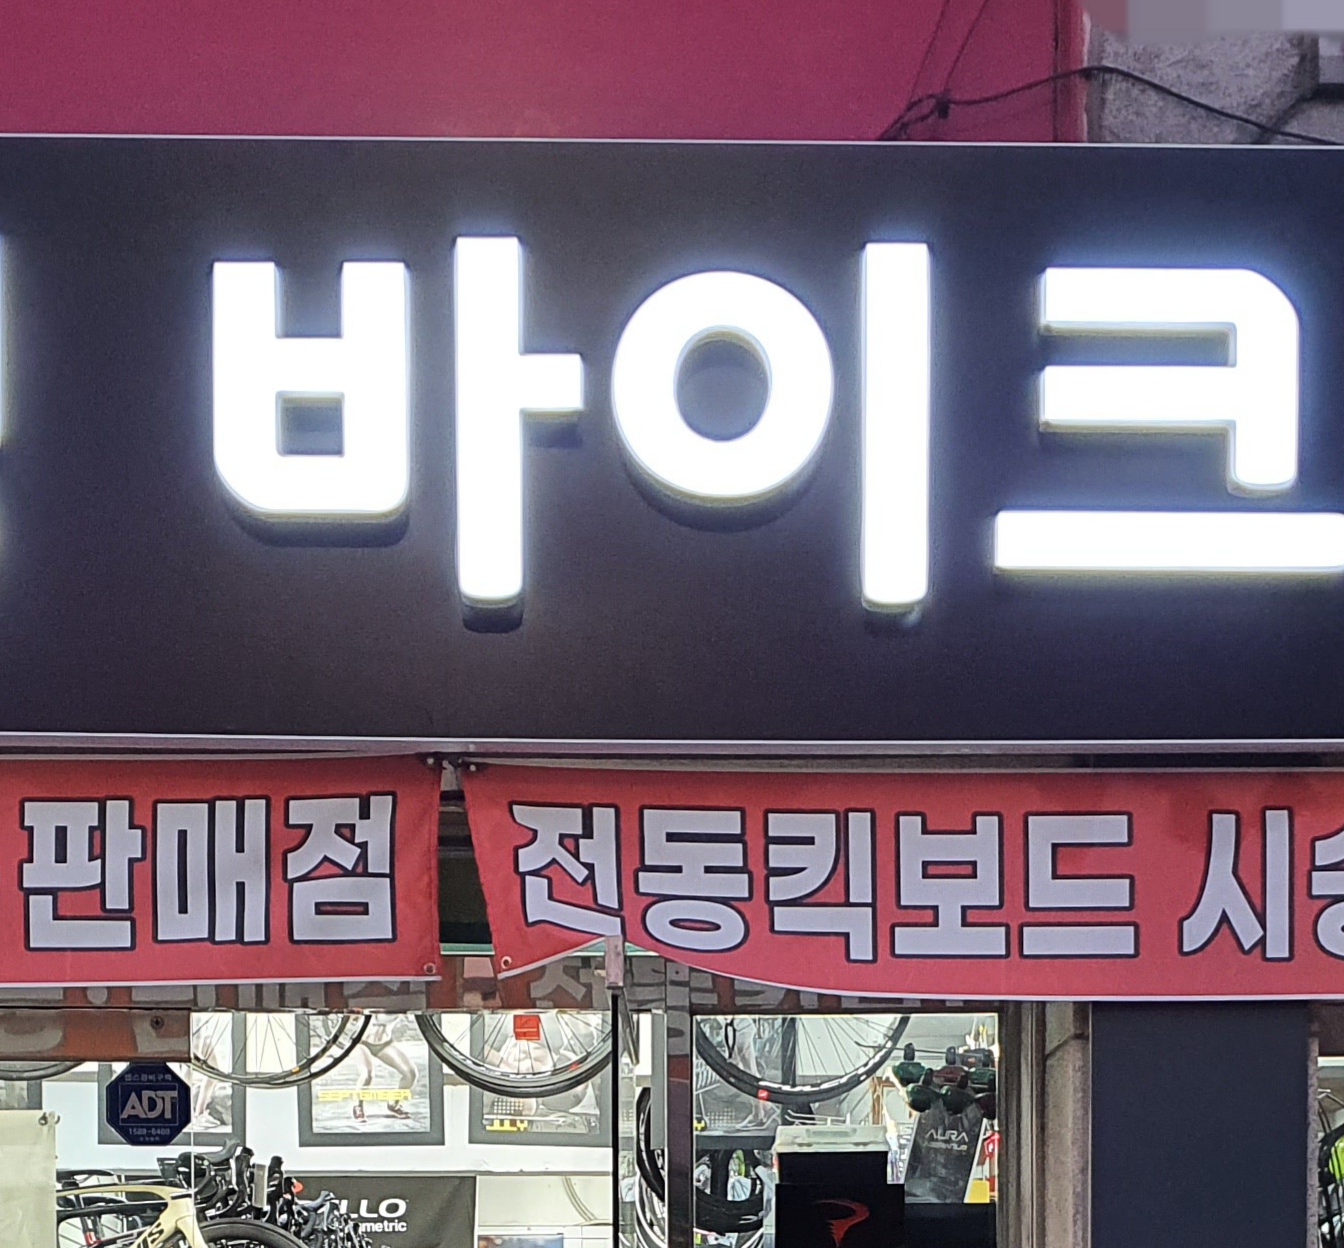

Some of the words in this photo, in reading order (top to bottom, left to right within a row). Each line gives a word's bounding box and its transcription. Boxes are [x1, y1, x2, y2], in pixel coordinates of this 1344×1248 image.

[509, 802, 1139, 961] 전동킥보드
[121, 1090, 177, 1119] ADT
[359, 1219, 407, 1232] metric
